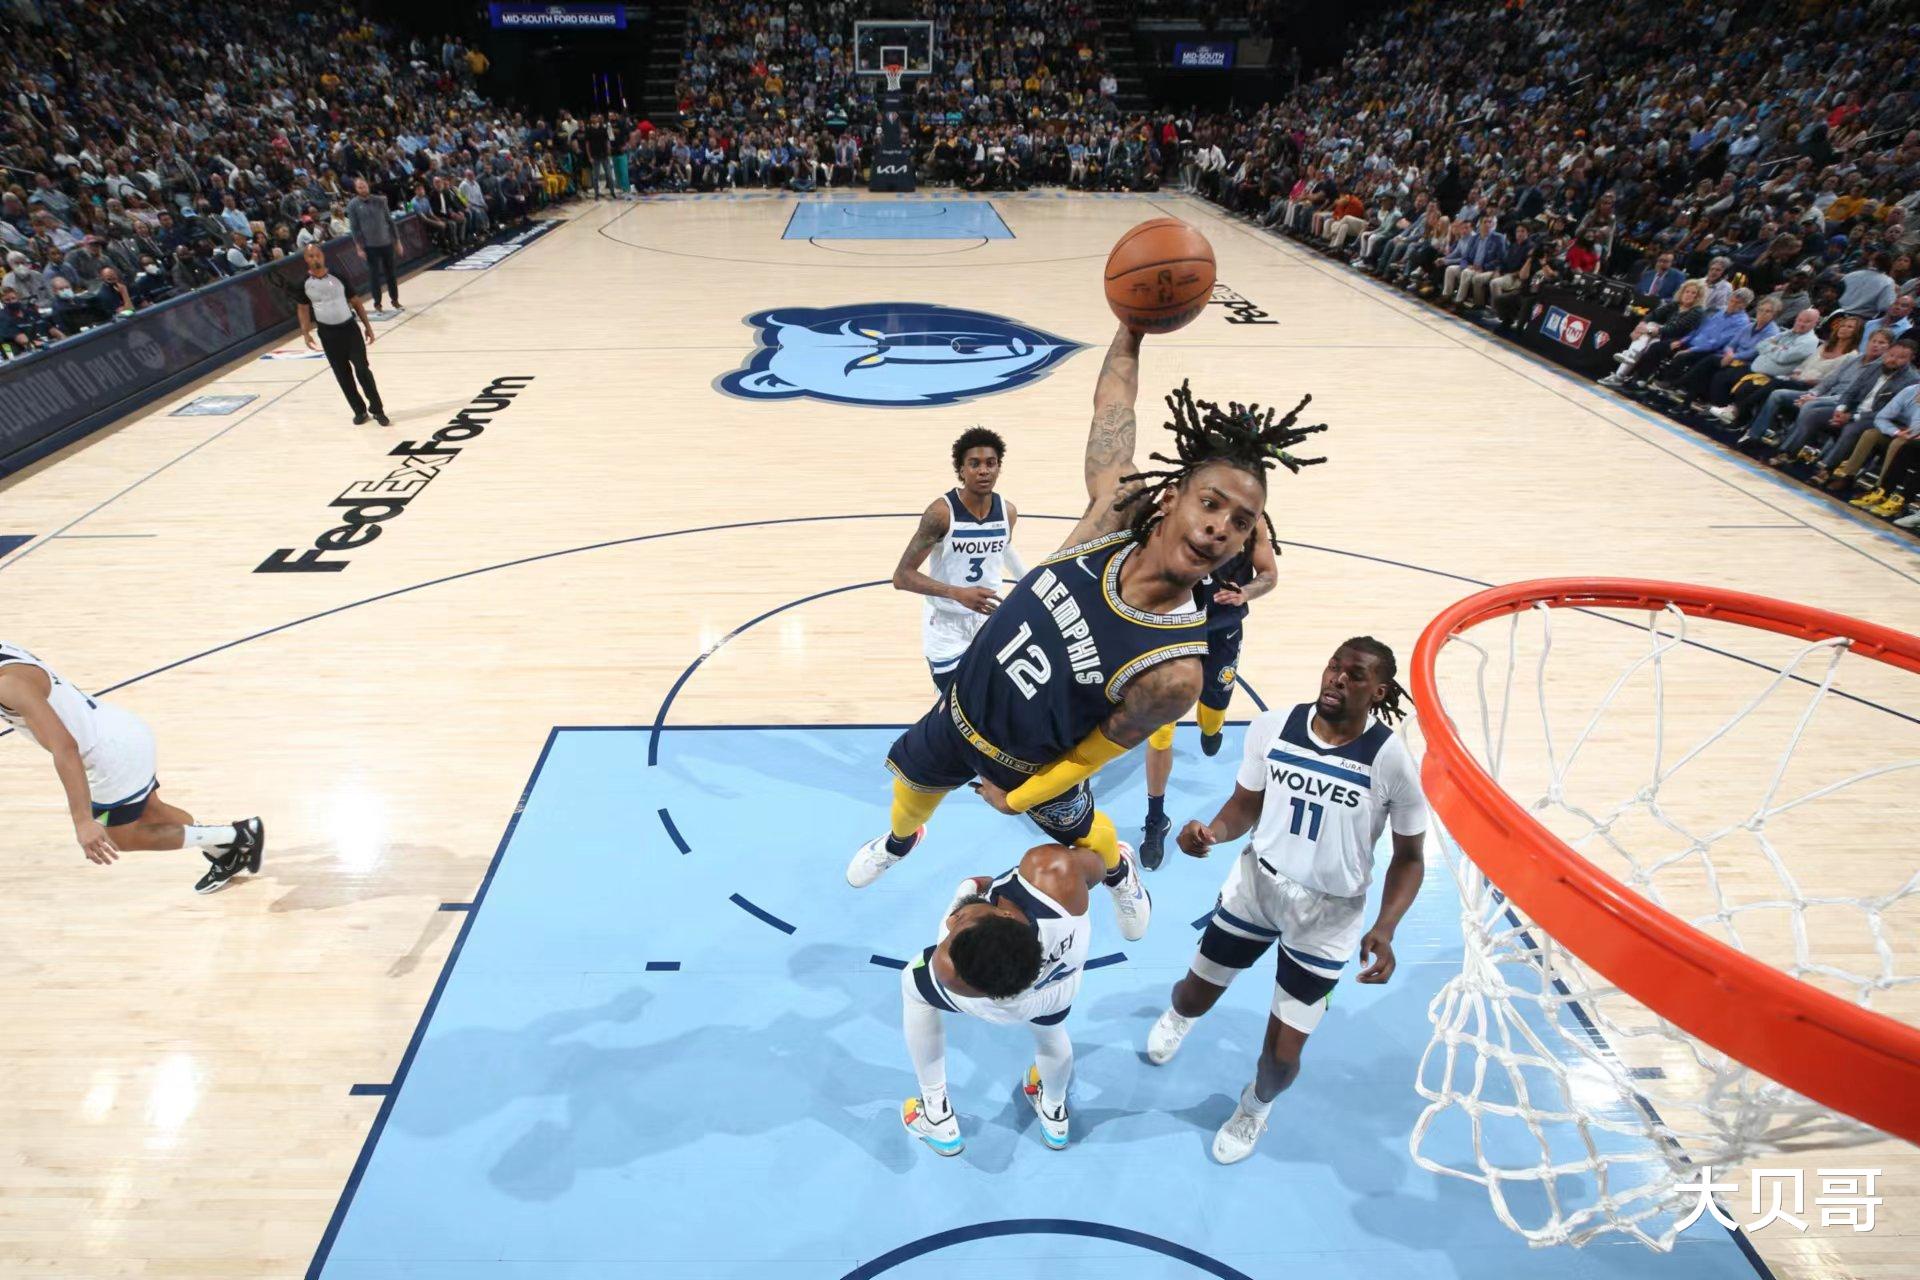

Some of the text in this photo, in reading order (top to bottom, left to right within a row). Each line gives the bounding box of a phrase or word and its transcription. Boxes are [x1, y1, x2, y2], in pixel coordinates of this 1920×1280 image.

[502, 15, 616, 24] MID-SOUTH FORD DEALERS
[877, 165, 907, 174] KIA
[252, 376, 535, 573] FedExForum
[952, 540, 1004, 554] WOLVES
[965, 557, 986, 583] 3
[1031, 568, 1104, 685] MEMPHIS
[996, 620, 1052, 700] 12
[1270, 765, 1360, 808] WOLVES
[1289, 796, 1324, 842] 11
